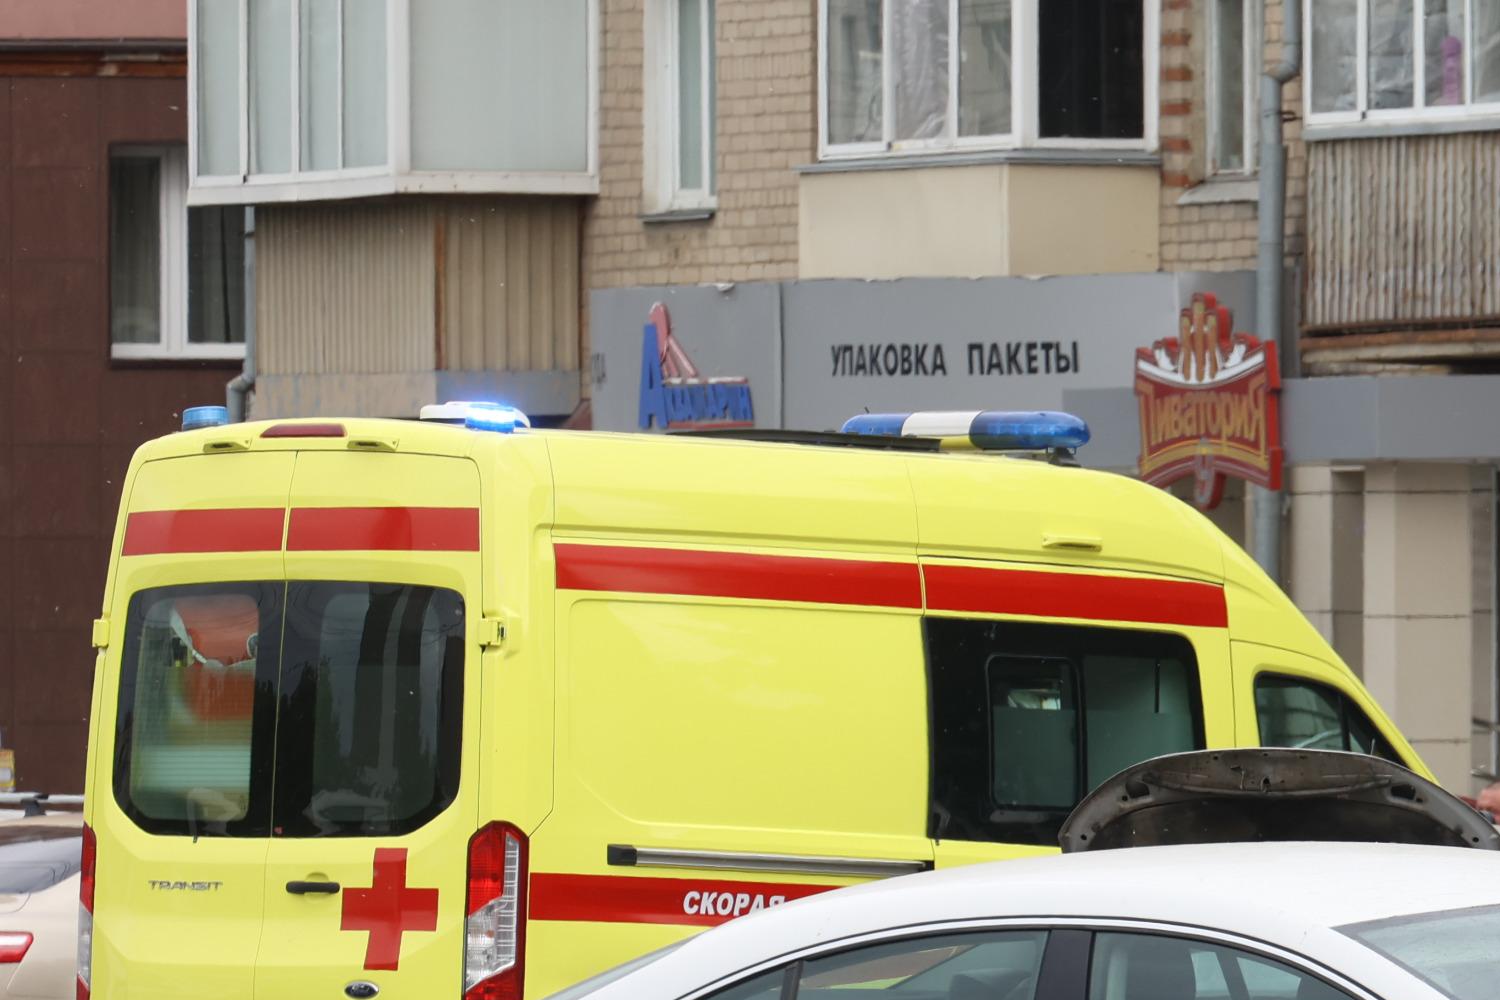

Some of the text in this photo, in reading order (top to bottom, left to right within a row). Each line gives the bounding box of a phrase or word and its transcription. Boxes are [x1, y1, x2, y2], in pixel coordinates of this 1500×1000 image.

[831, 340, 1080, 376] УПАКОВКА ПАКЕТЫ
[148, 880, 223, 891] TRANSIT
